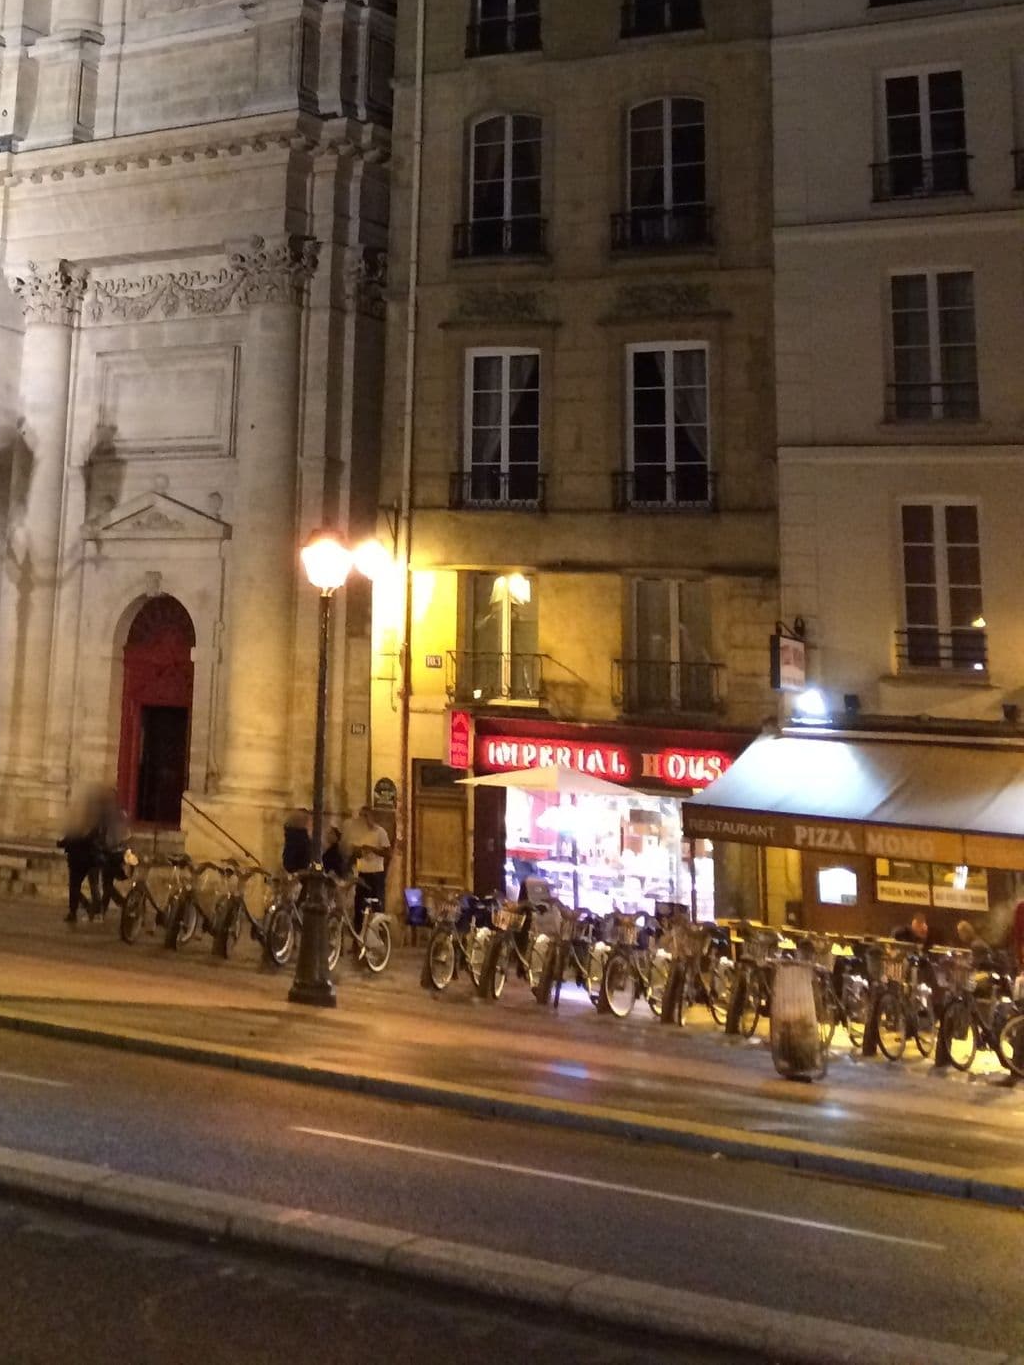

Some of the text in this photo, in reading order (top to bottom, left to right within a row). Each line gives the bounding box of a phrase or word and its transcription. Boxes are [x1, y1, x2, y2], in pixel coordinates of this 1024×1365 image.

[487, 741, 626, 776] IMPERIAL
[688, 818, 936, 858] RESTAURANT PIZZA MOMO
